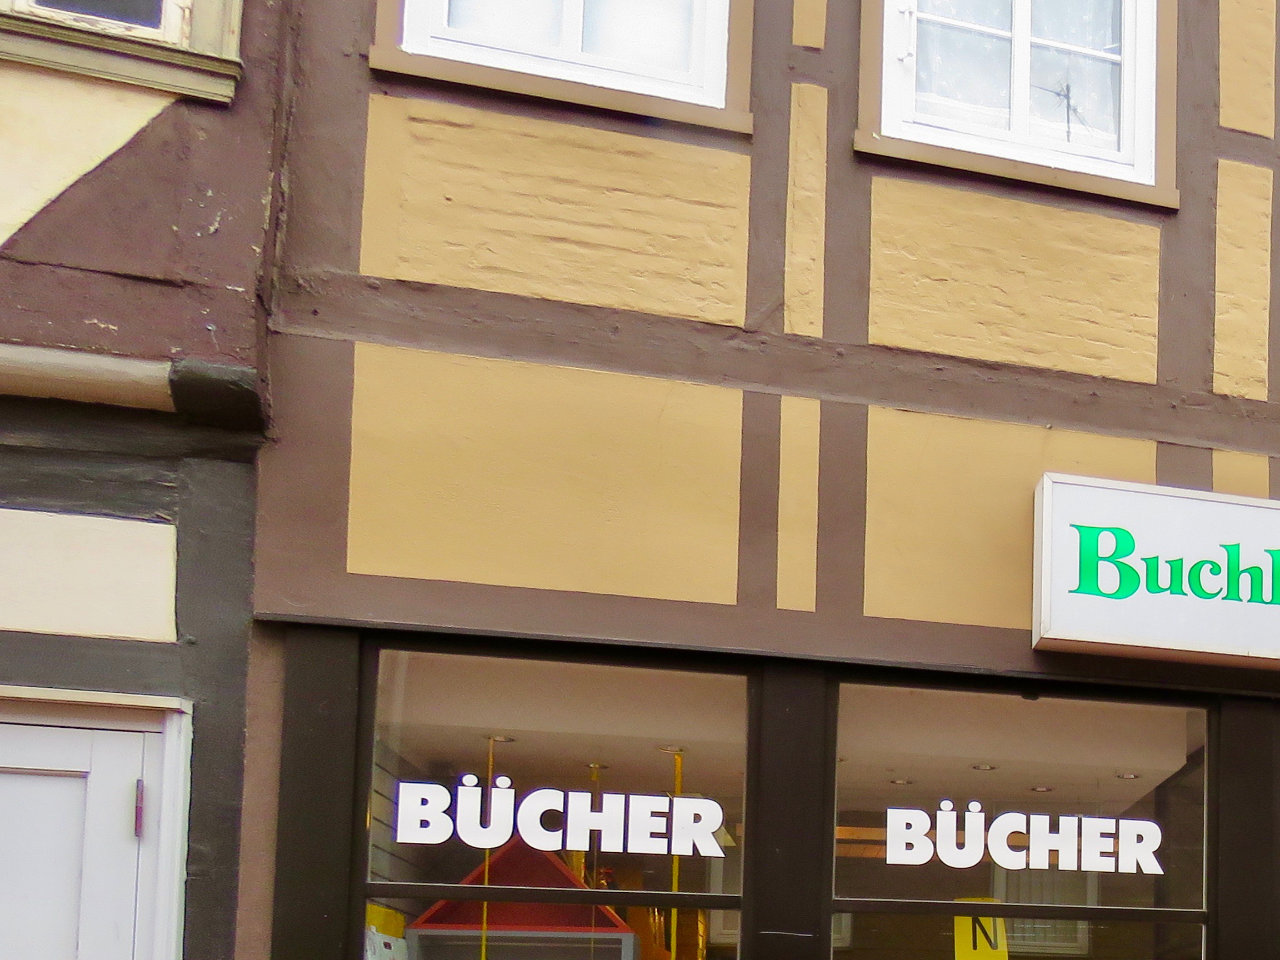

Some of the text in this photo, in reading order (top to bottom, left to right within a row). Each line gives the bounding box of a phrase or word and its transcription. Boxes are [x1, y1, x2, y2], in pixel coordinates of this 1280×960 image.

[396, 774, 726, 858] BÜCHER
[884, 800, 1164, 875] BÜCHER
[971, 916, 998, 951] N
